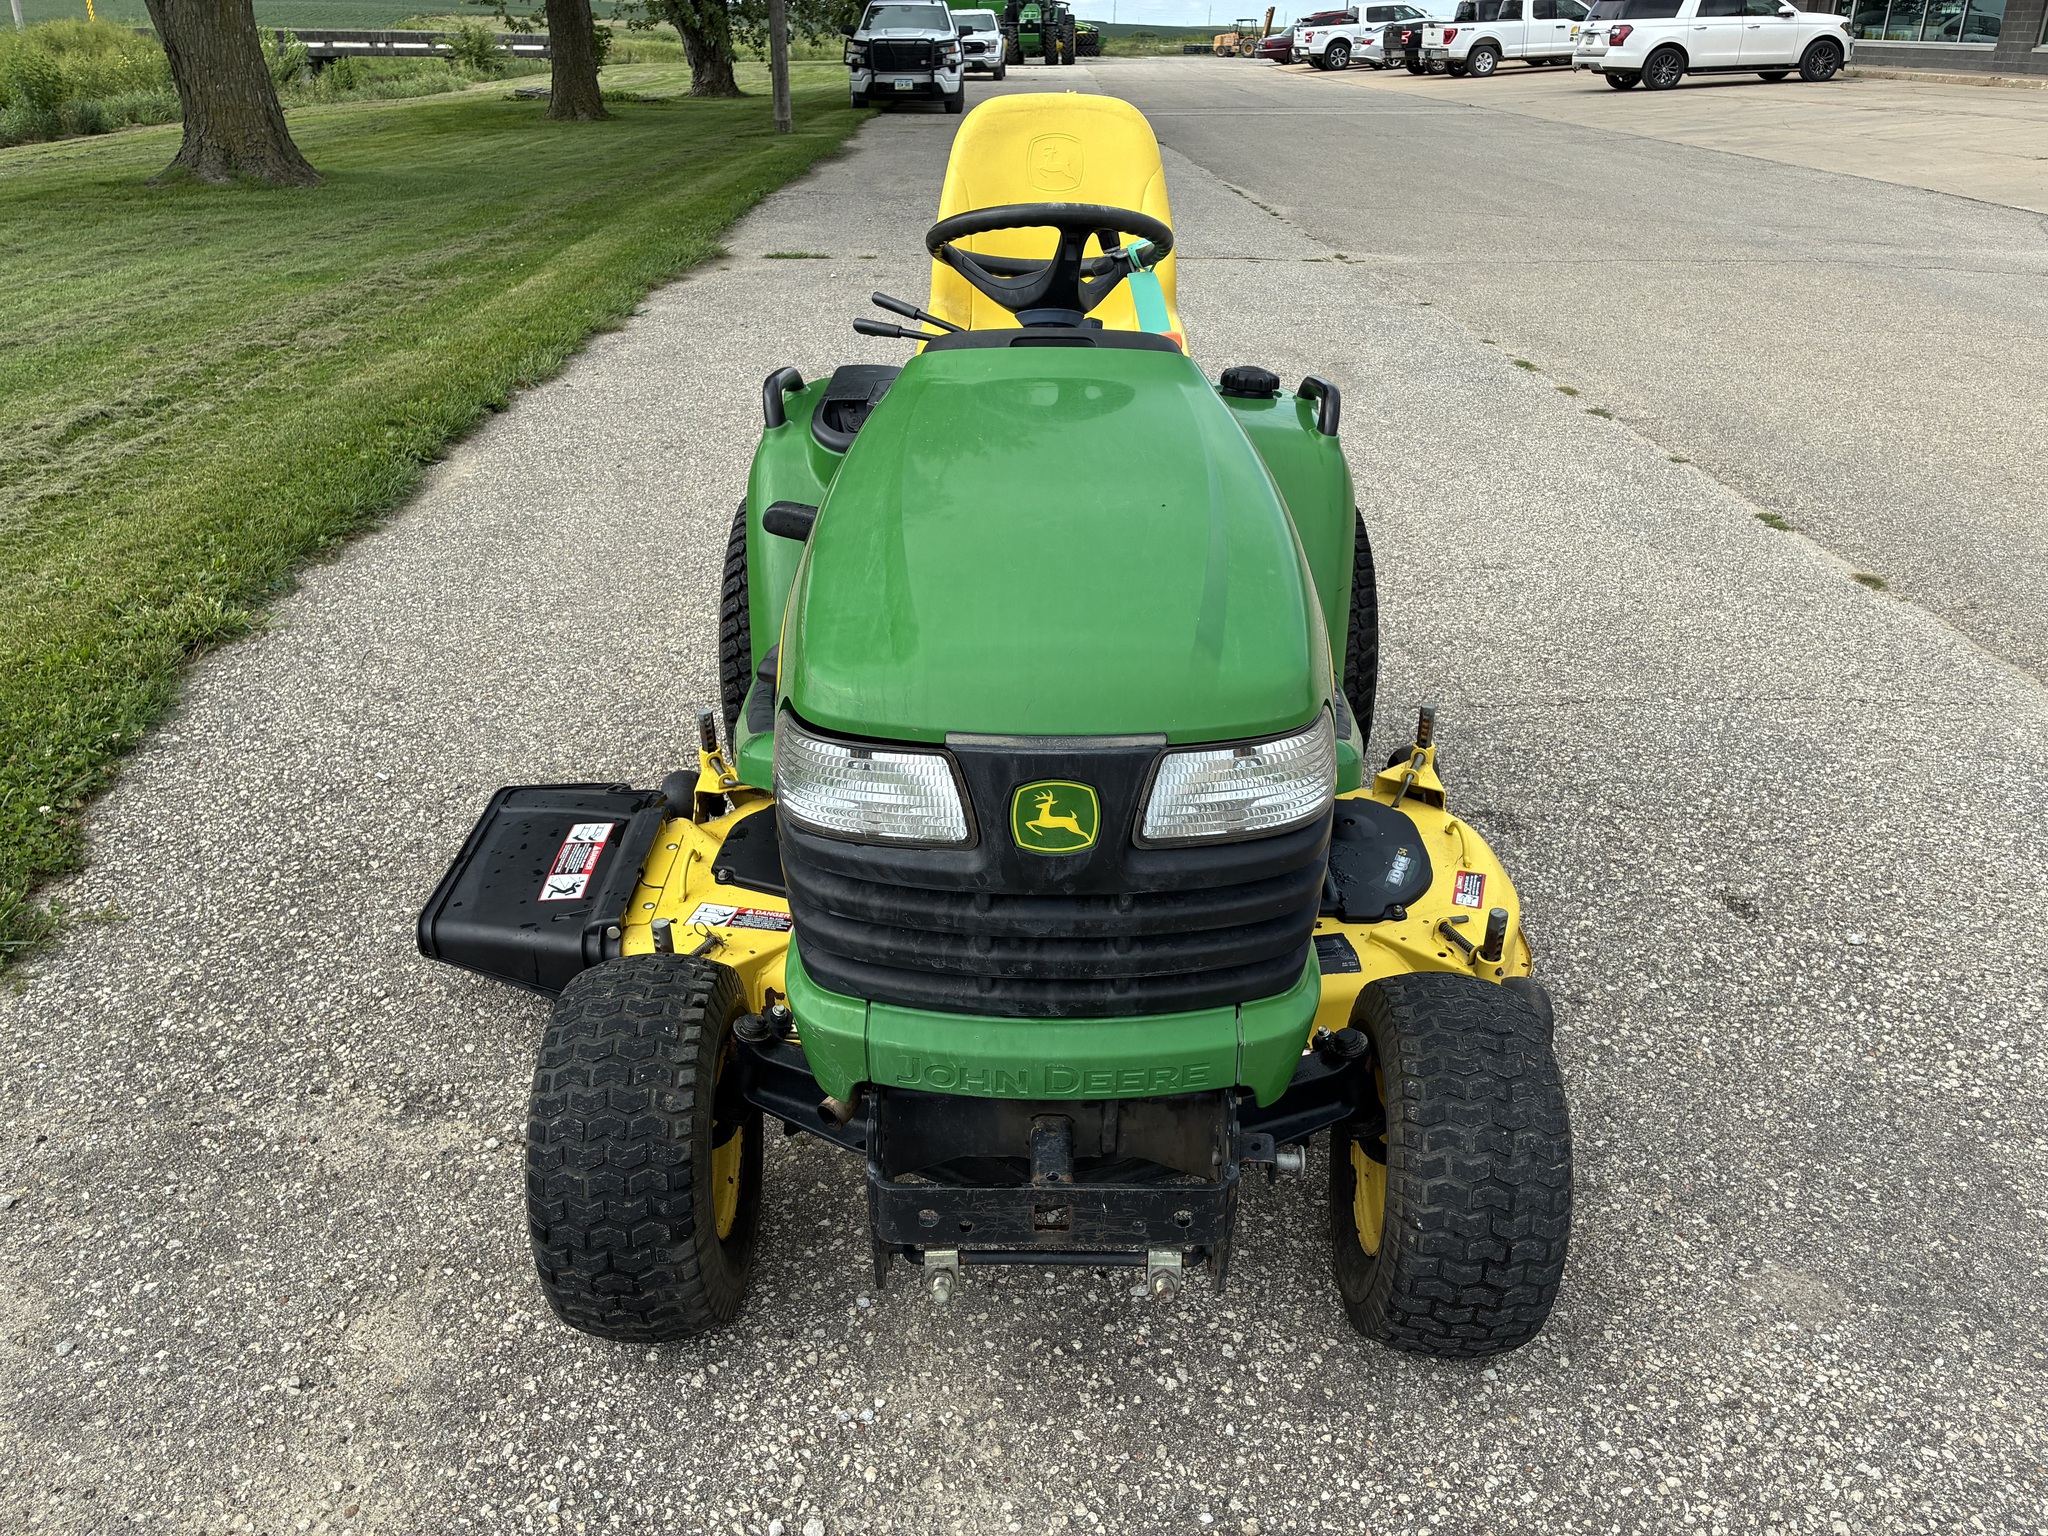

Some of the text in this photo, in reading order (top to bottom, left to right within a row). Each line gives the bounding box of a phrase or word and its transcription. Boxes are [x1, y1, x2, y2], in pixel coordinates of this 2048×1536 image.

[1387, 854, 1411, 887] EDGE
[754, 910, 790, 918] DANGER
[897, 1056, 1211, 1095] JOHN DEERE
